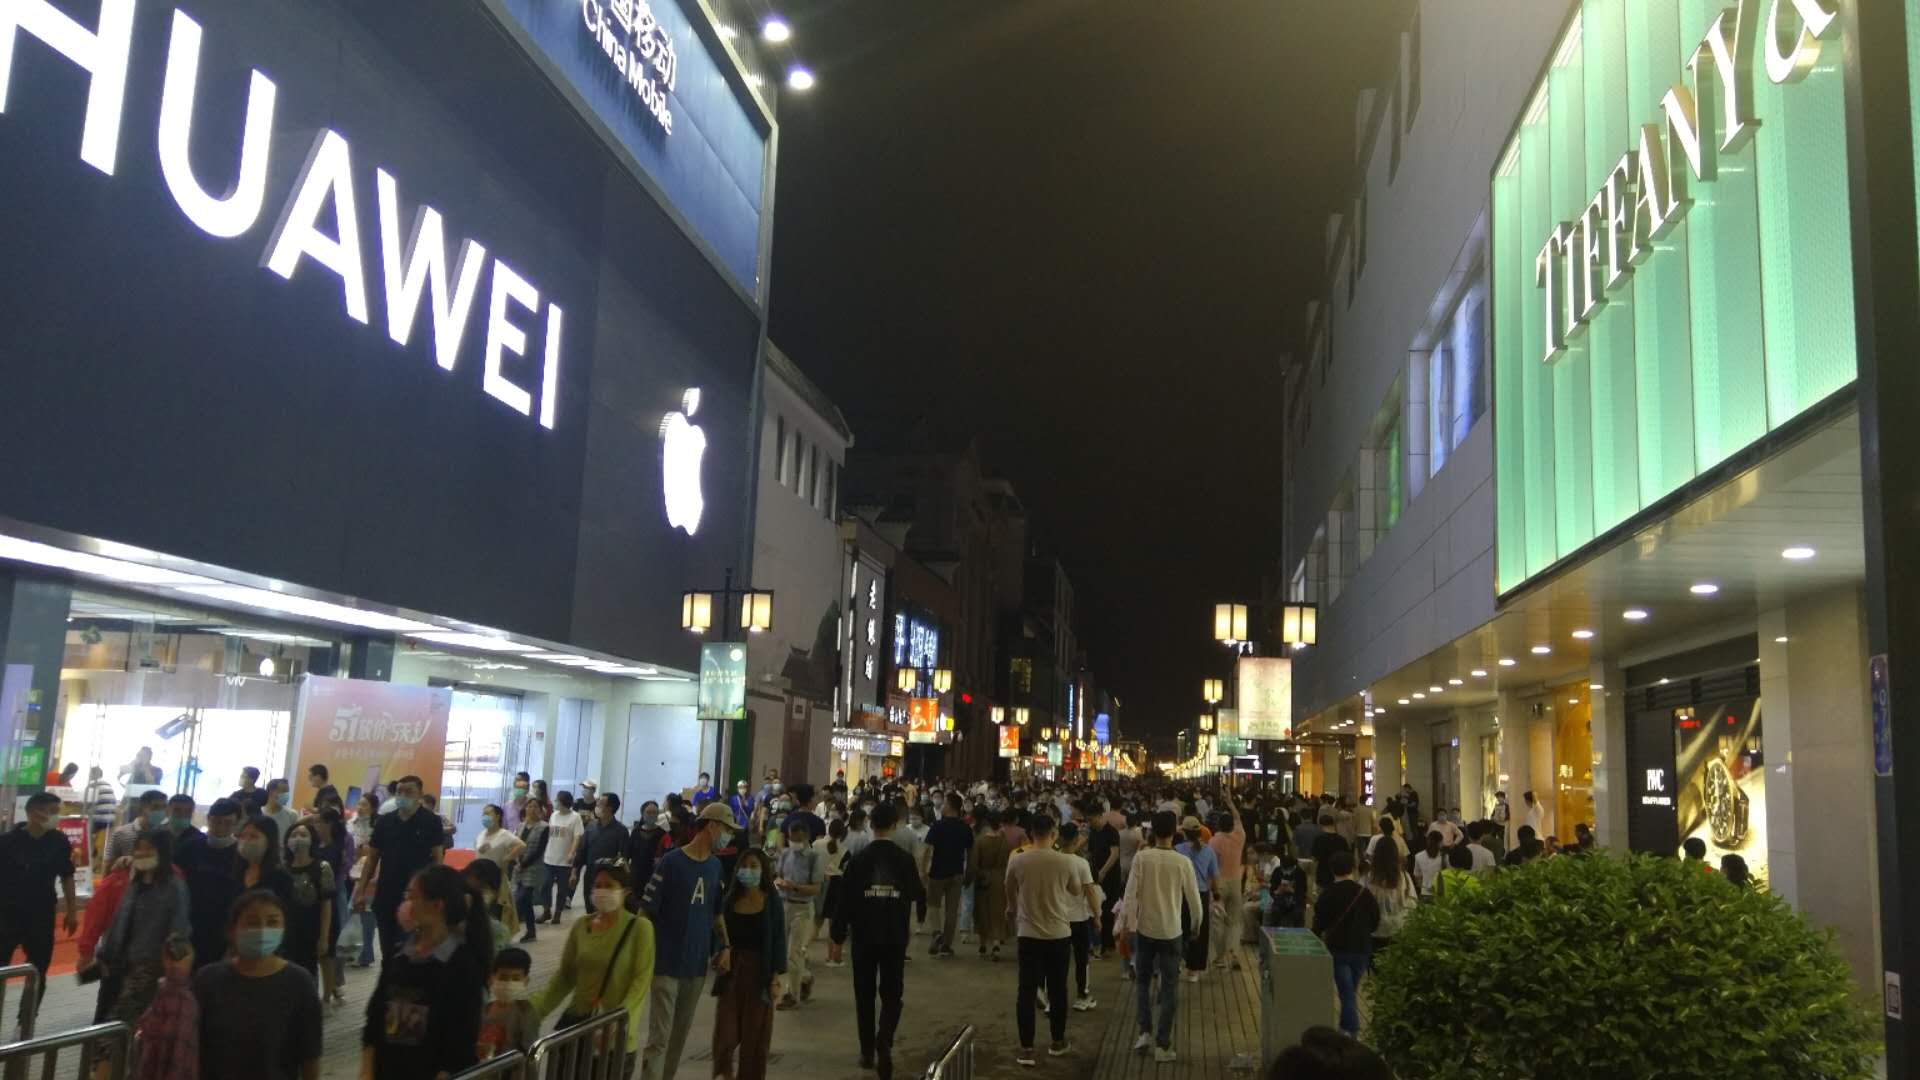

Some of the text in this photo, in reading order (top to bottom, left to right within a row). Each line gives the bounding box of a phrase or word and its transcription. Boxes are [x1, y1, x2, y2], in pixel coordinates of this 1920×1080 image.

[583, 0, 672, 136] China Mobile
[1536, 0, 1762, 363] TIFFANY
[0, 0, 563, 430] HUAWEI
[691, 876, 704, 905] A
